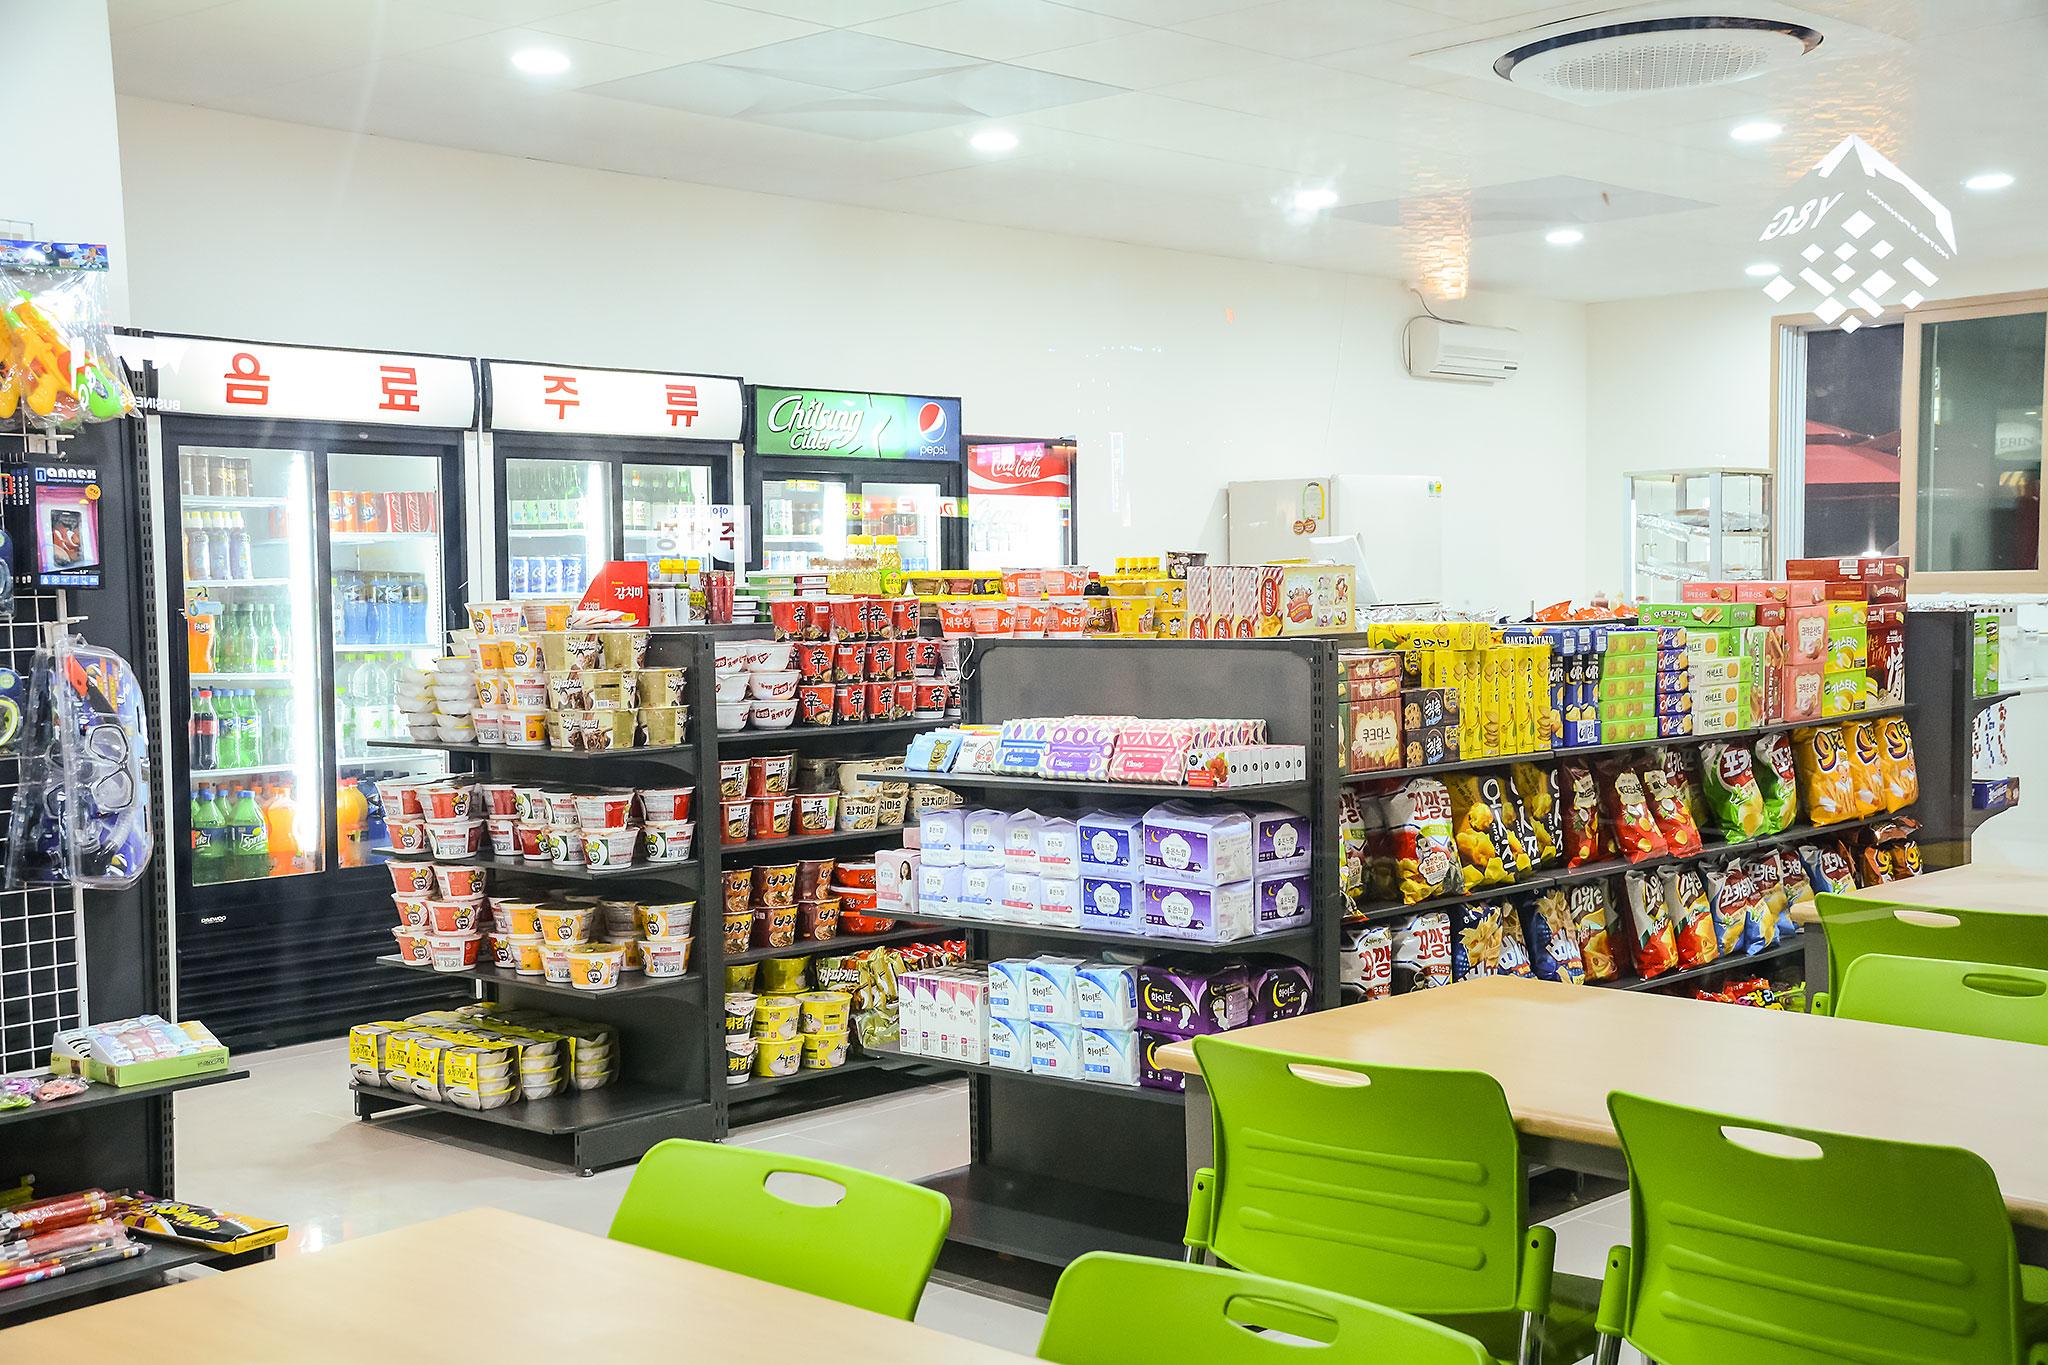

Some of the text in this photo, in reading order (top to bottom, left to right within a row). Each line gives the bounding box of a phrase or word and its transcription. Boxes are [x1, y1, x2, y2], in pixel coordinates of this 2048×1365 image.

[225, 352, 420, 413] 음 료
[544, 375, 699, 427] 주 류
[768, 394, 864, 449] Chilsung
[790, 431, 834, 451] Cider
[920, 443, 948, 456] pepsi
[46, 468, 97, 480] annex
[614, 586, 644, 600] 감치미
[945, 616, 973, 628] 새우탕
[1505, 635, 1554, 645] BAKED POTATO
[1362, 727, 1391, 743] 쿠크다스
[921, 796, 950, 807] 참치마요
[1406, 789, 1453, 821] 꼬깔콘
[846, 805, 877, 816] 참치마요
[1164, 846, 1187, 858] 좋은느낌
[1166, 905, 1190, 917] 좋은느낌
[819, 967, 860, 987] 짜파게티
[1032, 985, 1054, 997] 화이트
[1081, 990, 1103, 1003] 화이트
[1151, 991, 1174, 1004] 화이트
[1035, 1038, 1057, 1051] 화이트
[1087, 1045, 1110, 1057] 화이트
